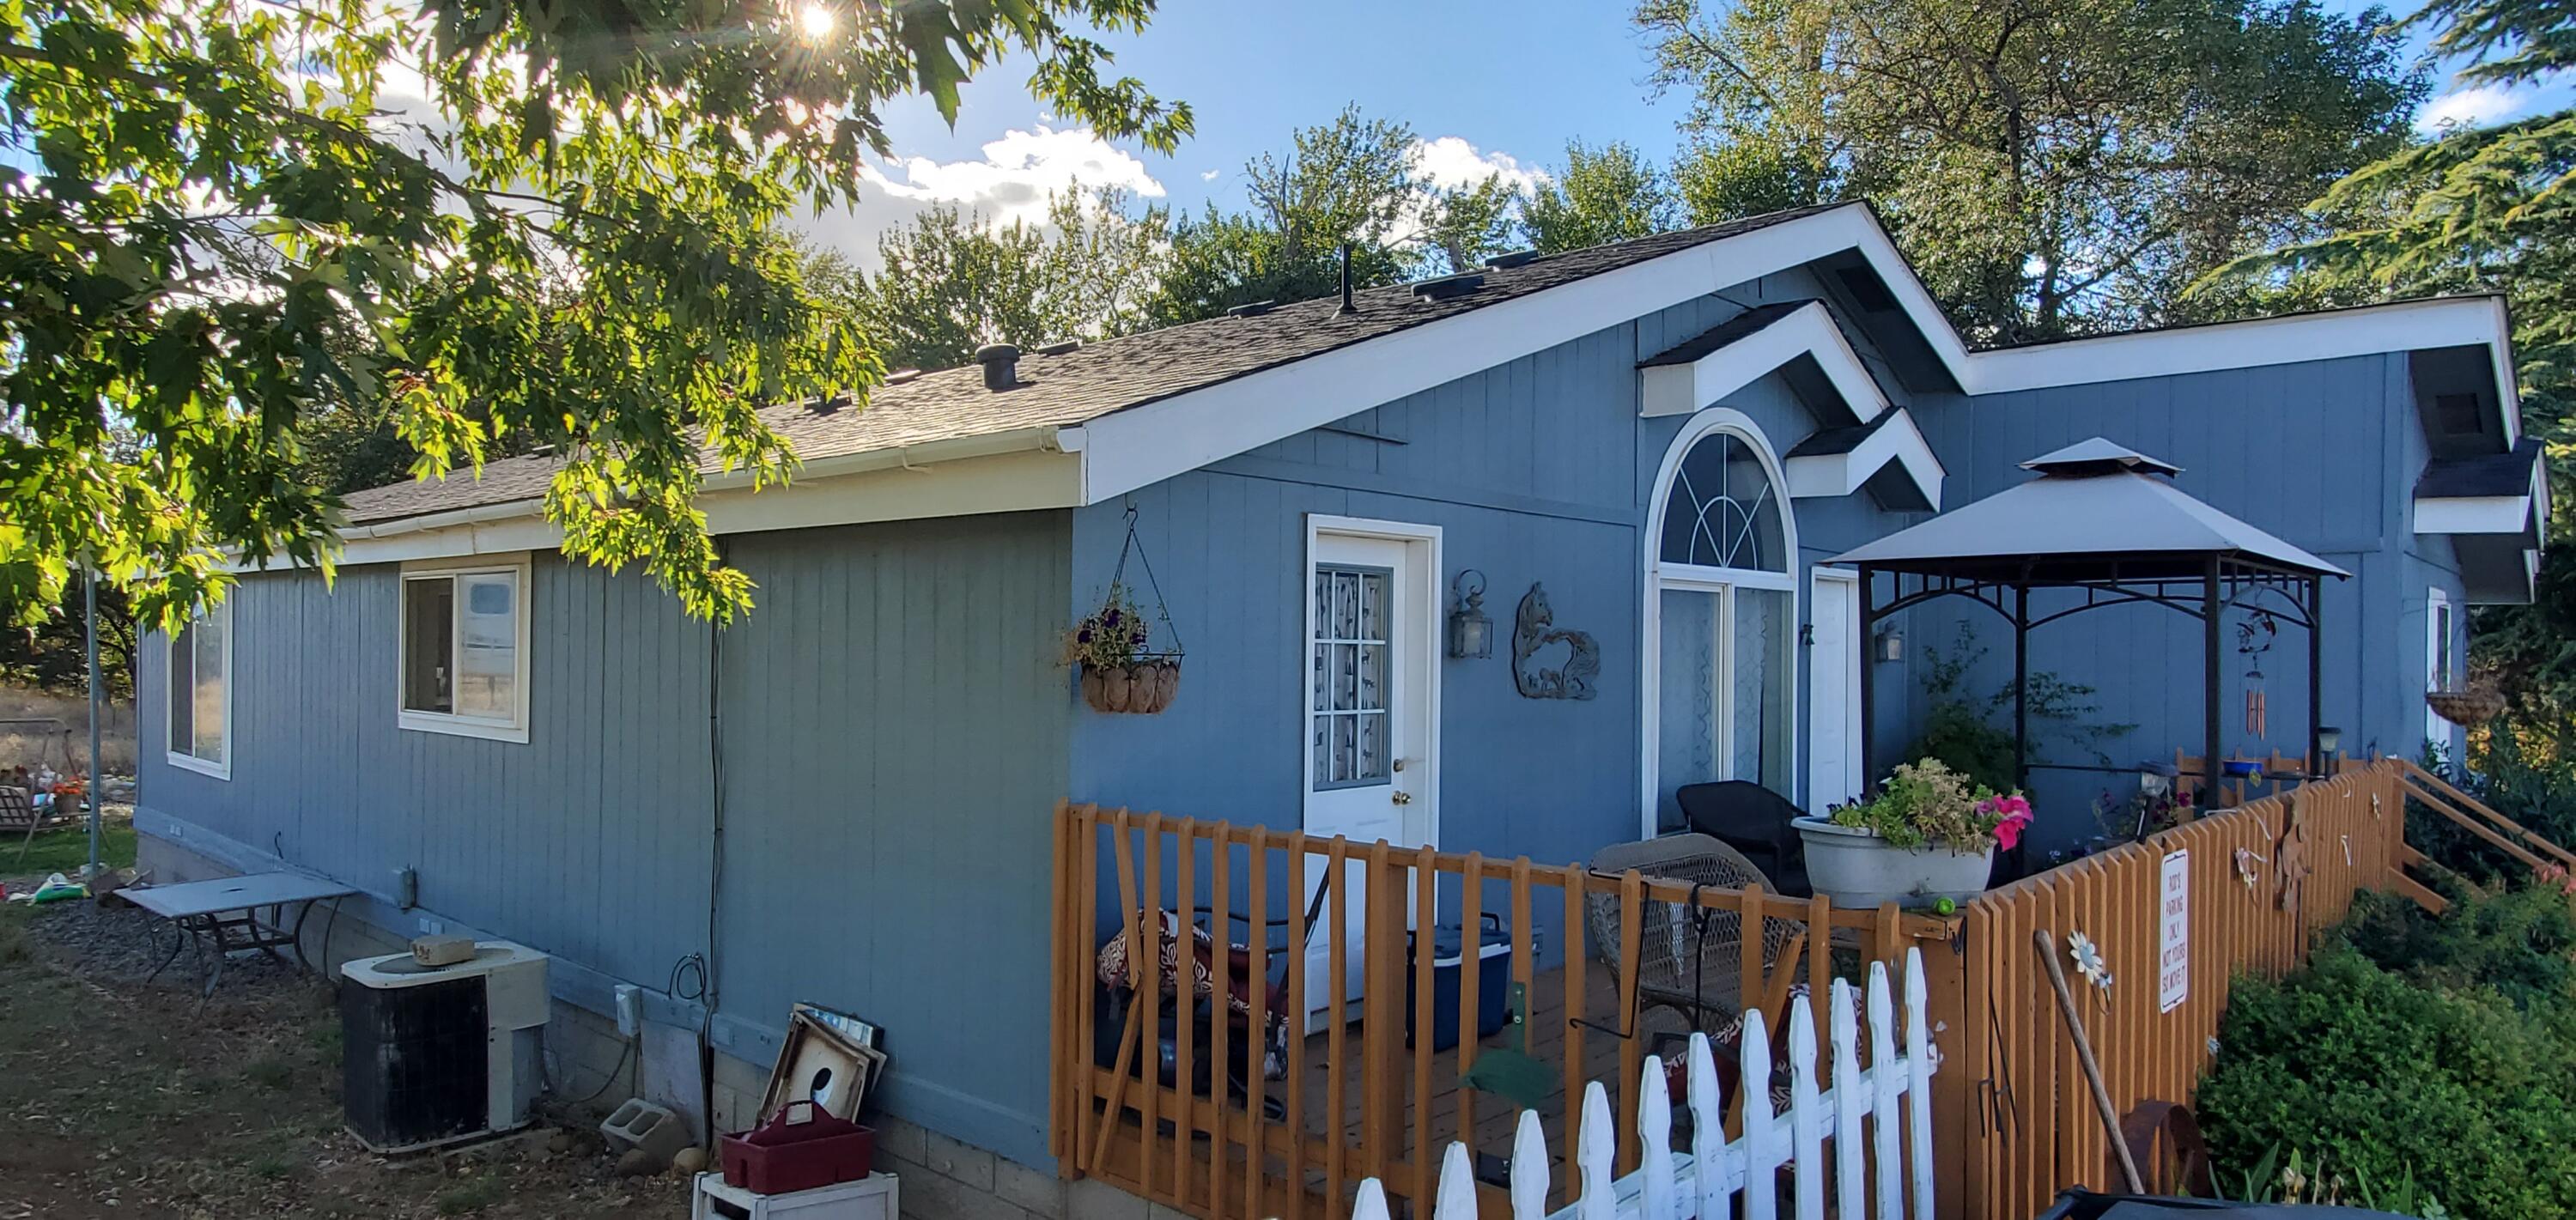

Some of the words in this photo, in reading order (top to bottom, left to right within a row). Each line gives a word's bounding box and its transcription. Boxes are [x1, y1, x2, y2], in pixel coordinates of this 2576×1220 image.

[2166, 895, 2183, 917] PARKING
[2169, 921, 2180, 942] ONLY
[2163, 949, 2172, 968] NOT
[2172, 942, 2185, 963] YOURS
[2162, 974, 2169, 993] SO
[2170, 968, 2180, 990] MOVE
